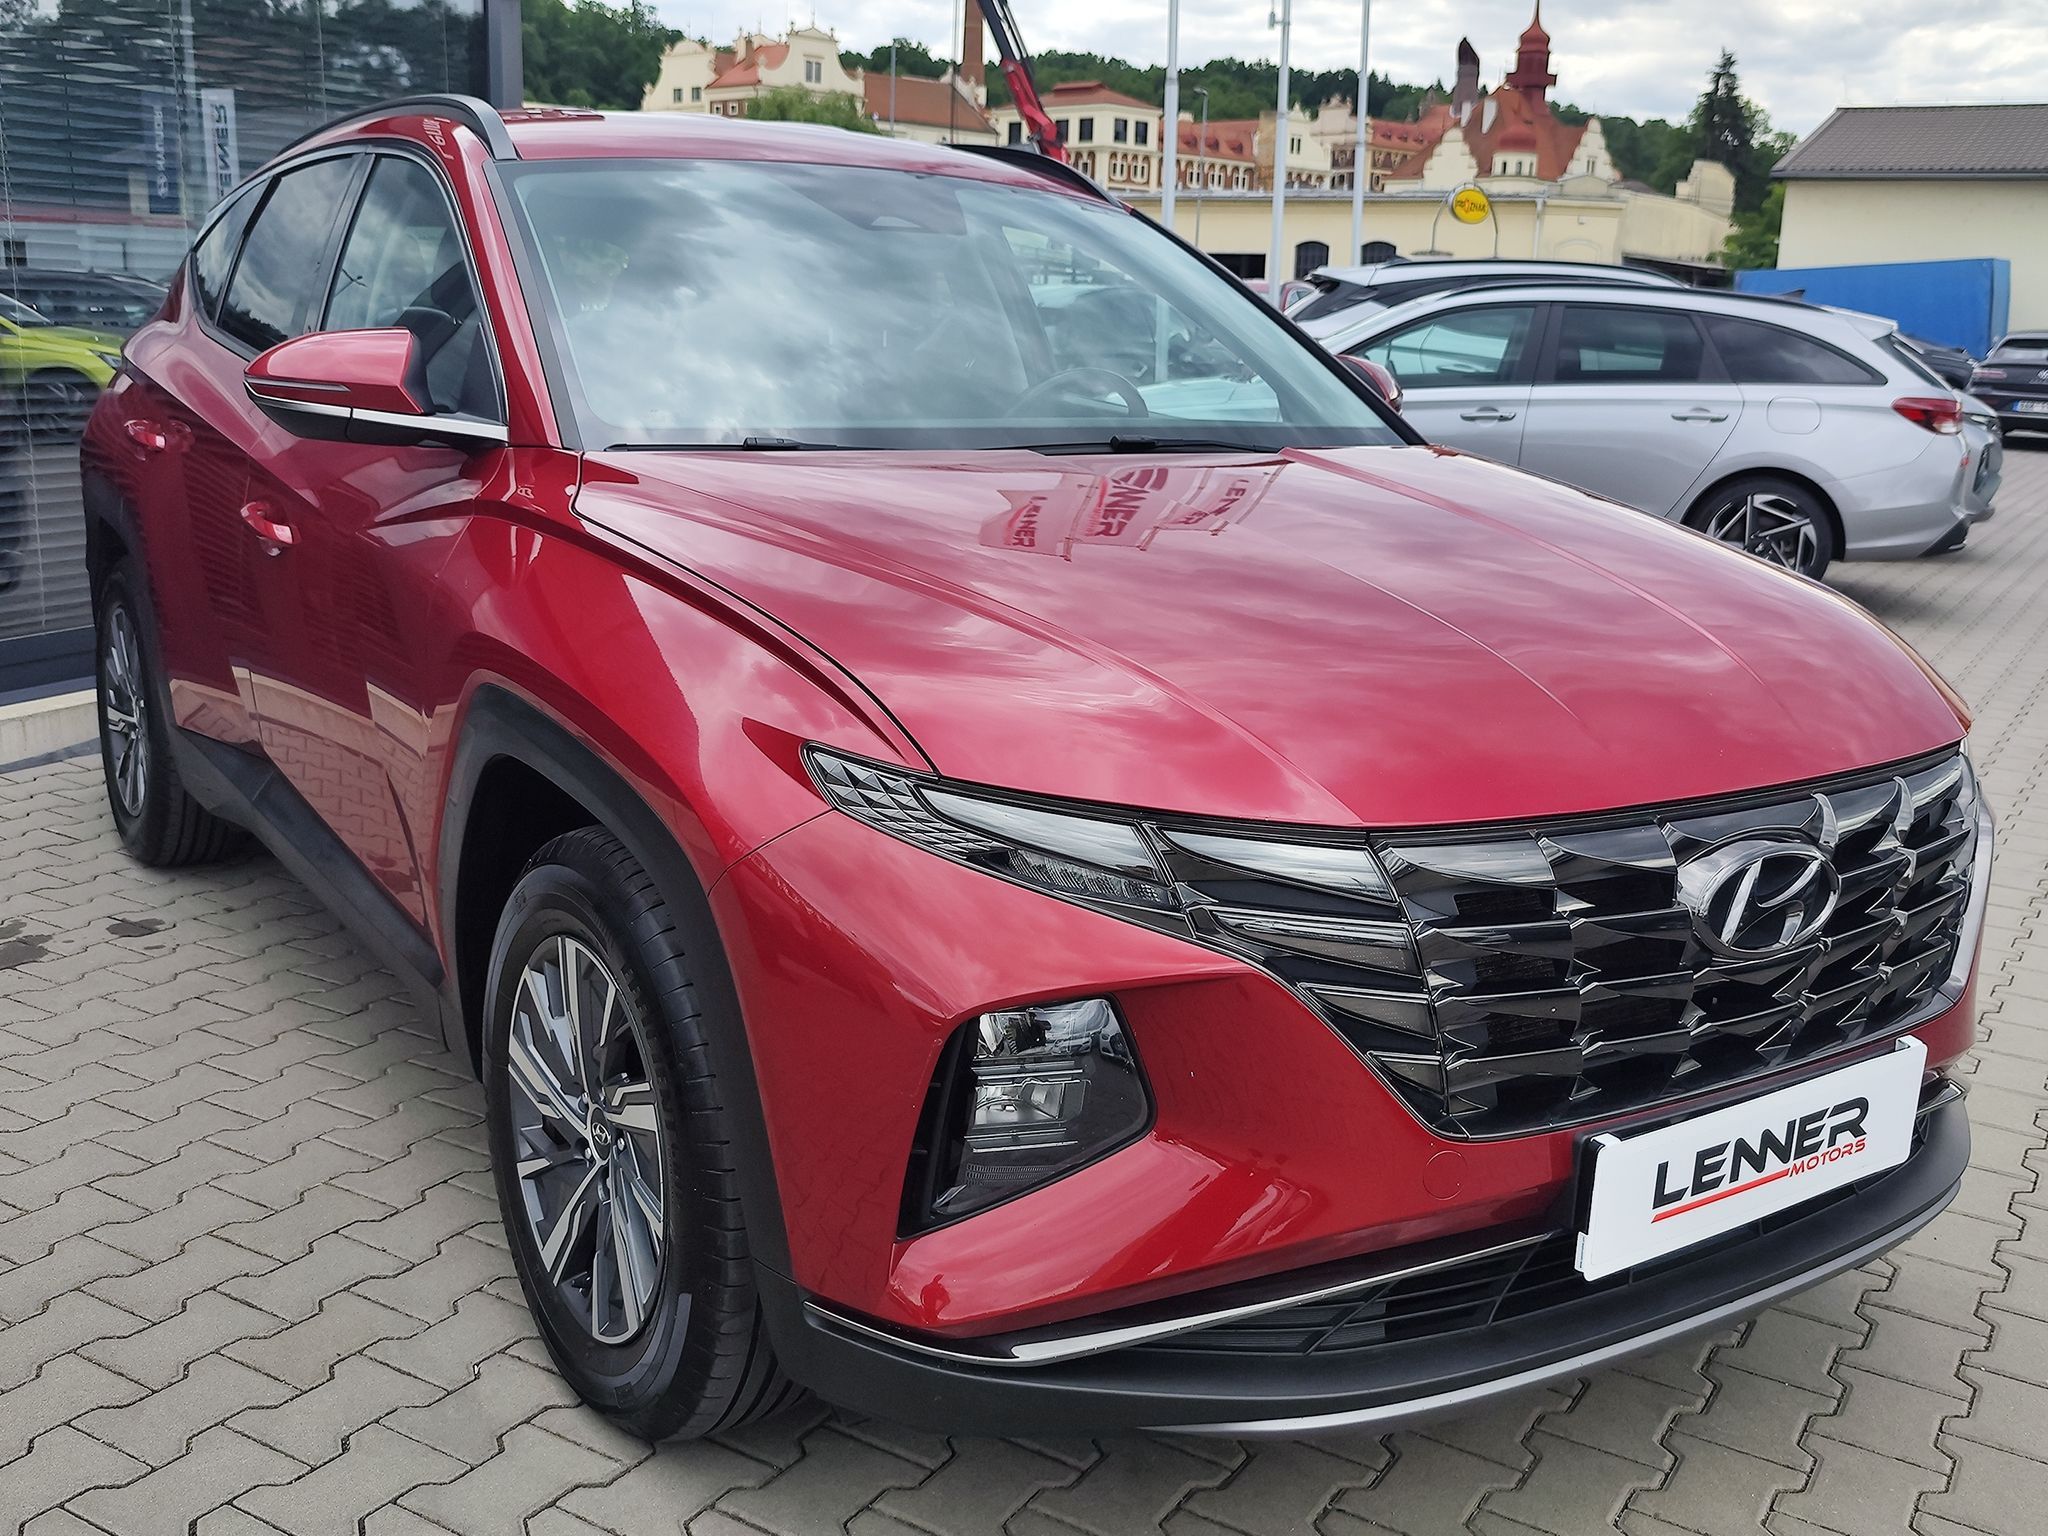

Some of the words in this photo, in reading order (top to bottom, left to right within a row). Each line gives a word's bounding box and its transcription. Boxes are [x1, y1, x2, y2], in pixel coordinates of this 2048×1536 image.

[1097, 467, 1169, 537] ENNER
[1652, 1096, 1869, 1210] LENNER
[1788, 1136, 1867, 1178] MOTORS
